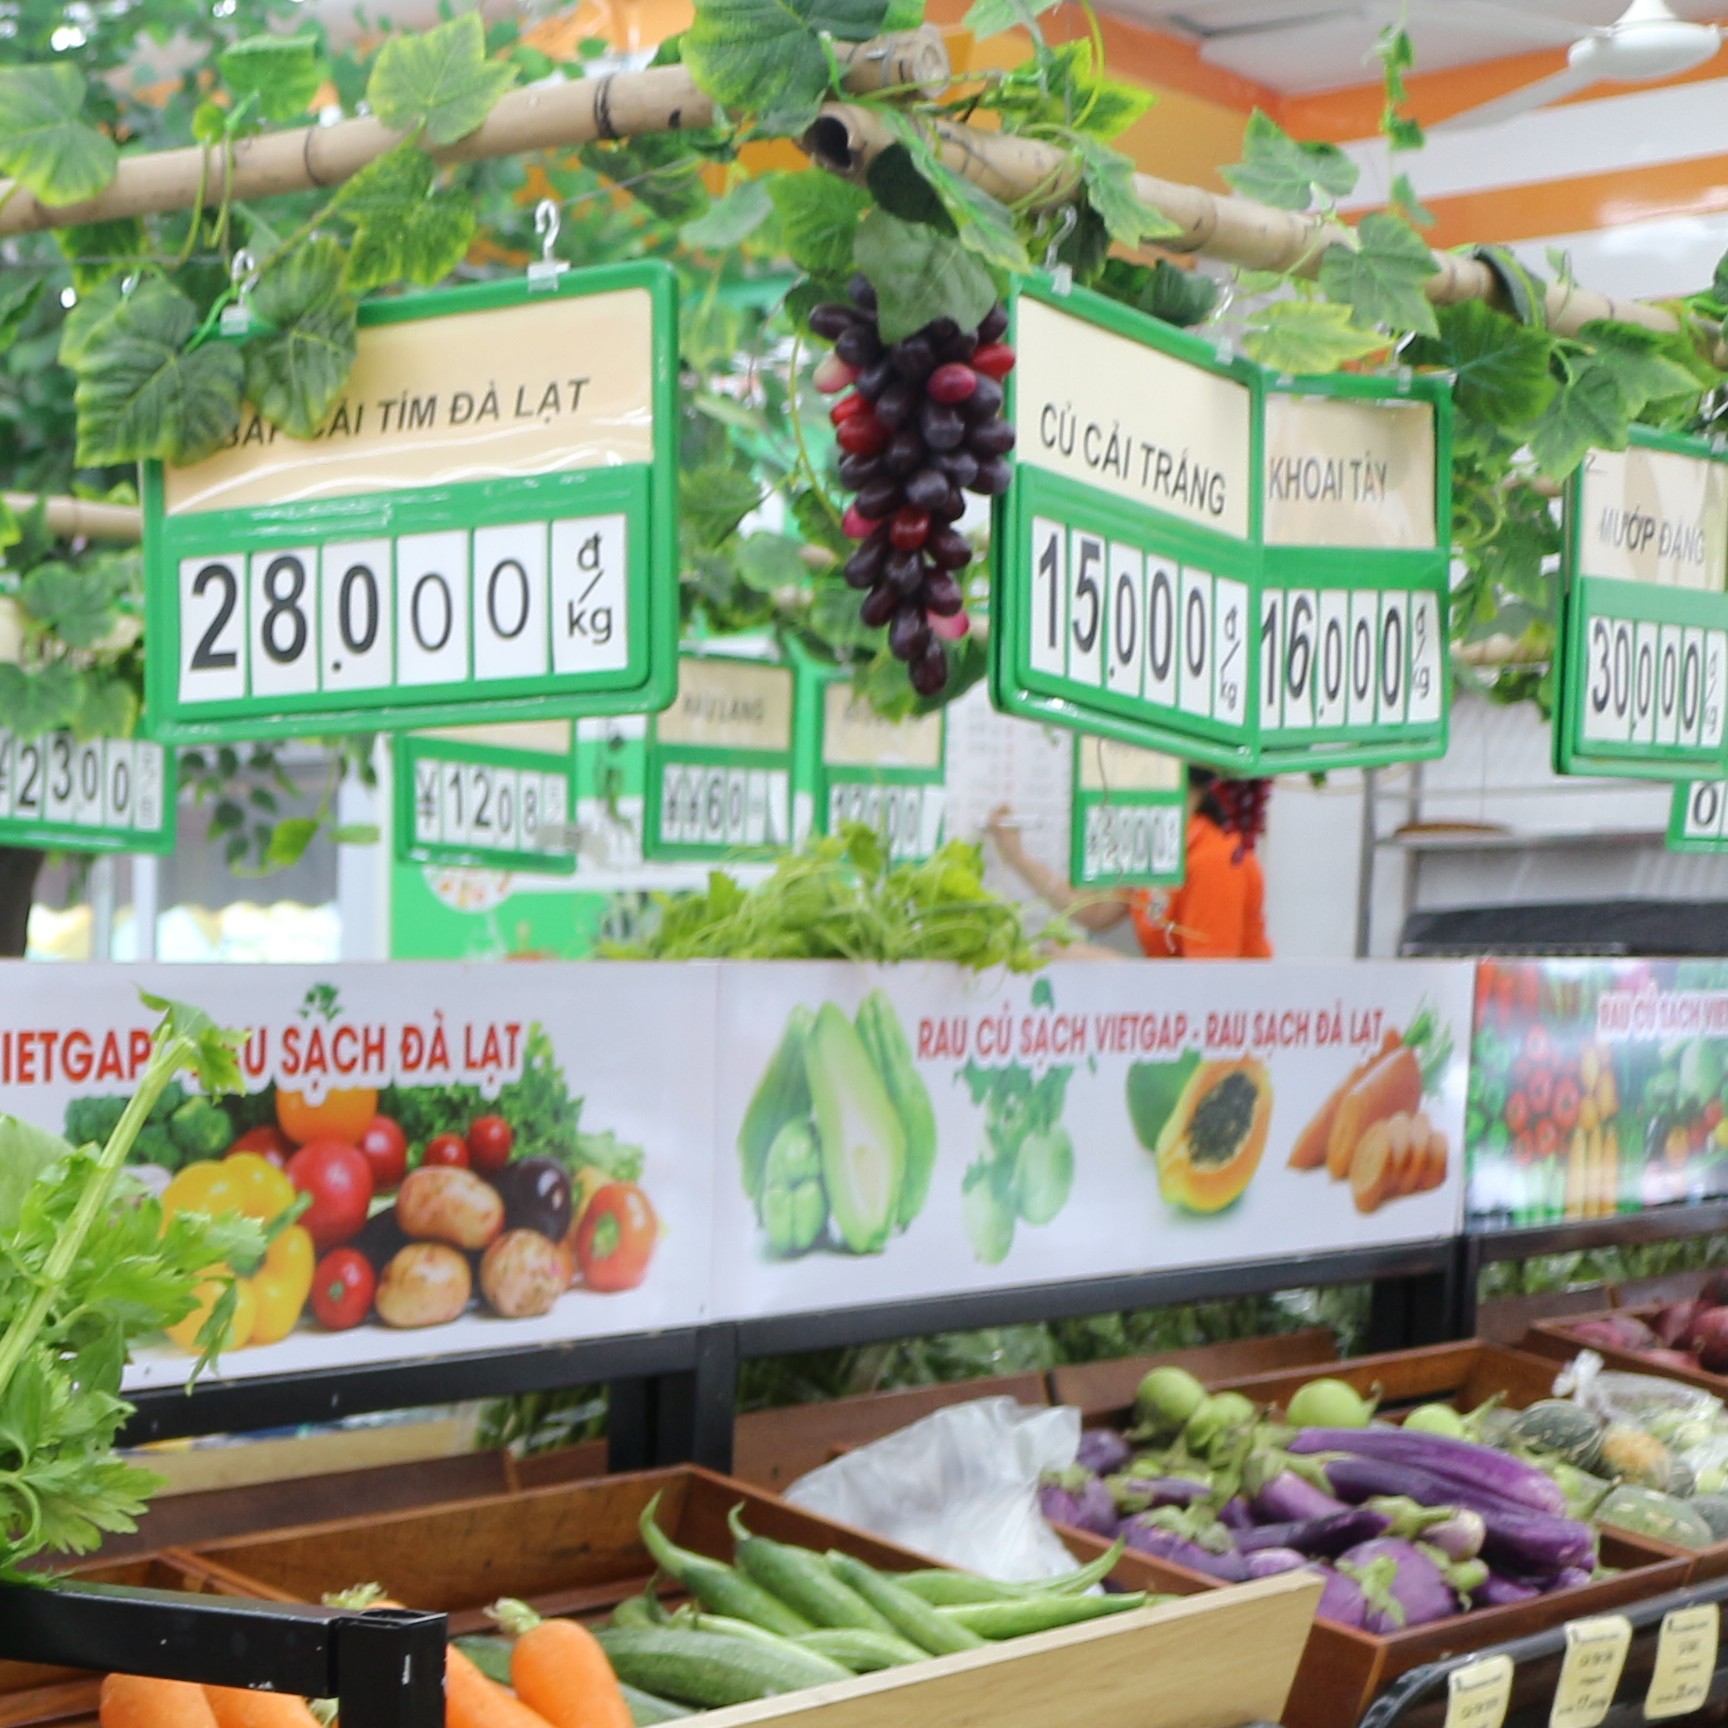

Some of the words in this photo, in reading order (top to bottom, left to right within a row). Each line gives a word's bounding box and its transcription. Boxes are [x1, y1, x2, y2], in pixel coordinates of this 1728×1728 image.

[376, 388, 438, 433] TÍM
[449, 380, 501, 425] ĐÀ
[514, 377, 591, 425] LẠT
[1040, 400, 1076, 455] CỦ
[1083, 419, 1132, 480] CẢI
[1269, 455, 1343, 500] KHOAI
[1350, 451, 1387, 501] TÂY
[281, 1025, 386, 1090] SẠCH
[400, 1009, 450, 1072] ĐÀ
[465, 1024, 521, 1086] LẠT
[918, 1017, 968, 1059] RAU
[1020, 1015, 1088, 1068] SẠCH
[1095, 1012, 1189, 1053] VIETGAP
[1205, 1010, 1246, 1048] RAU
[1252, 1009, 1309, 1060] SẠCH
